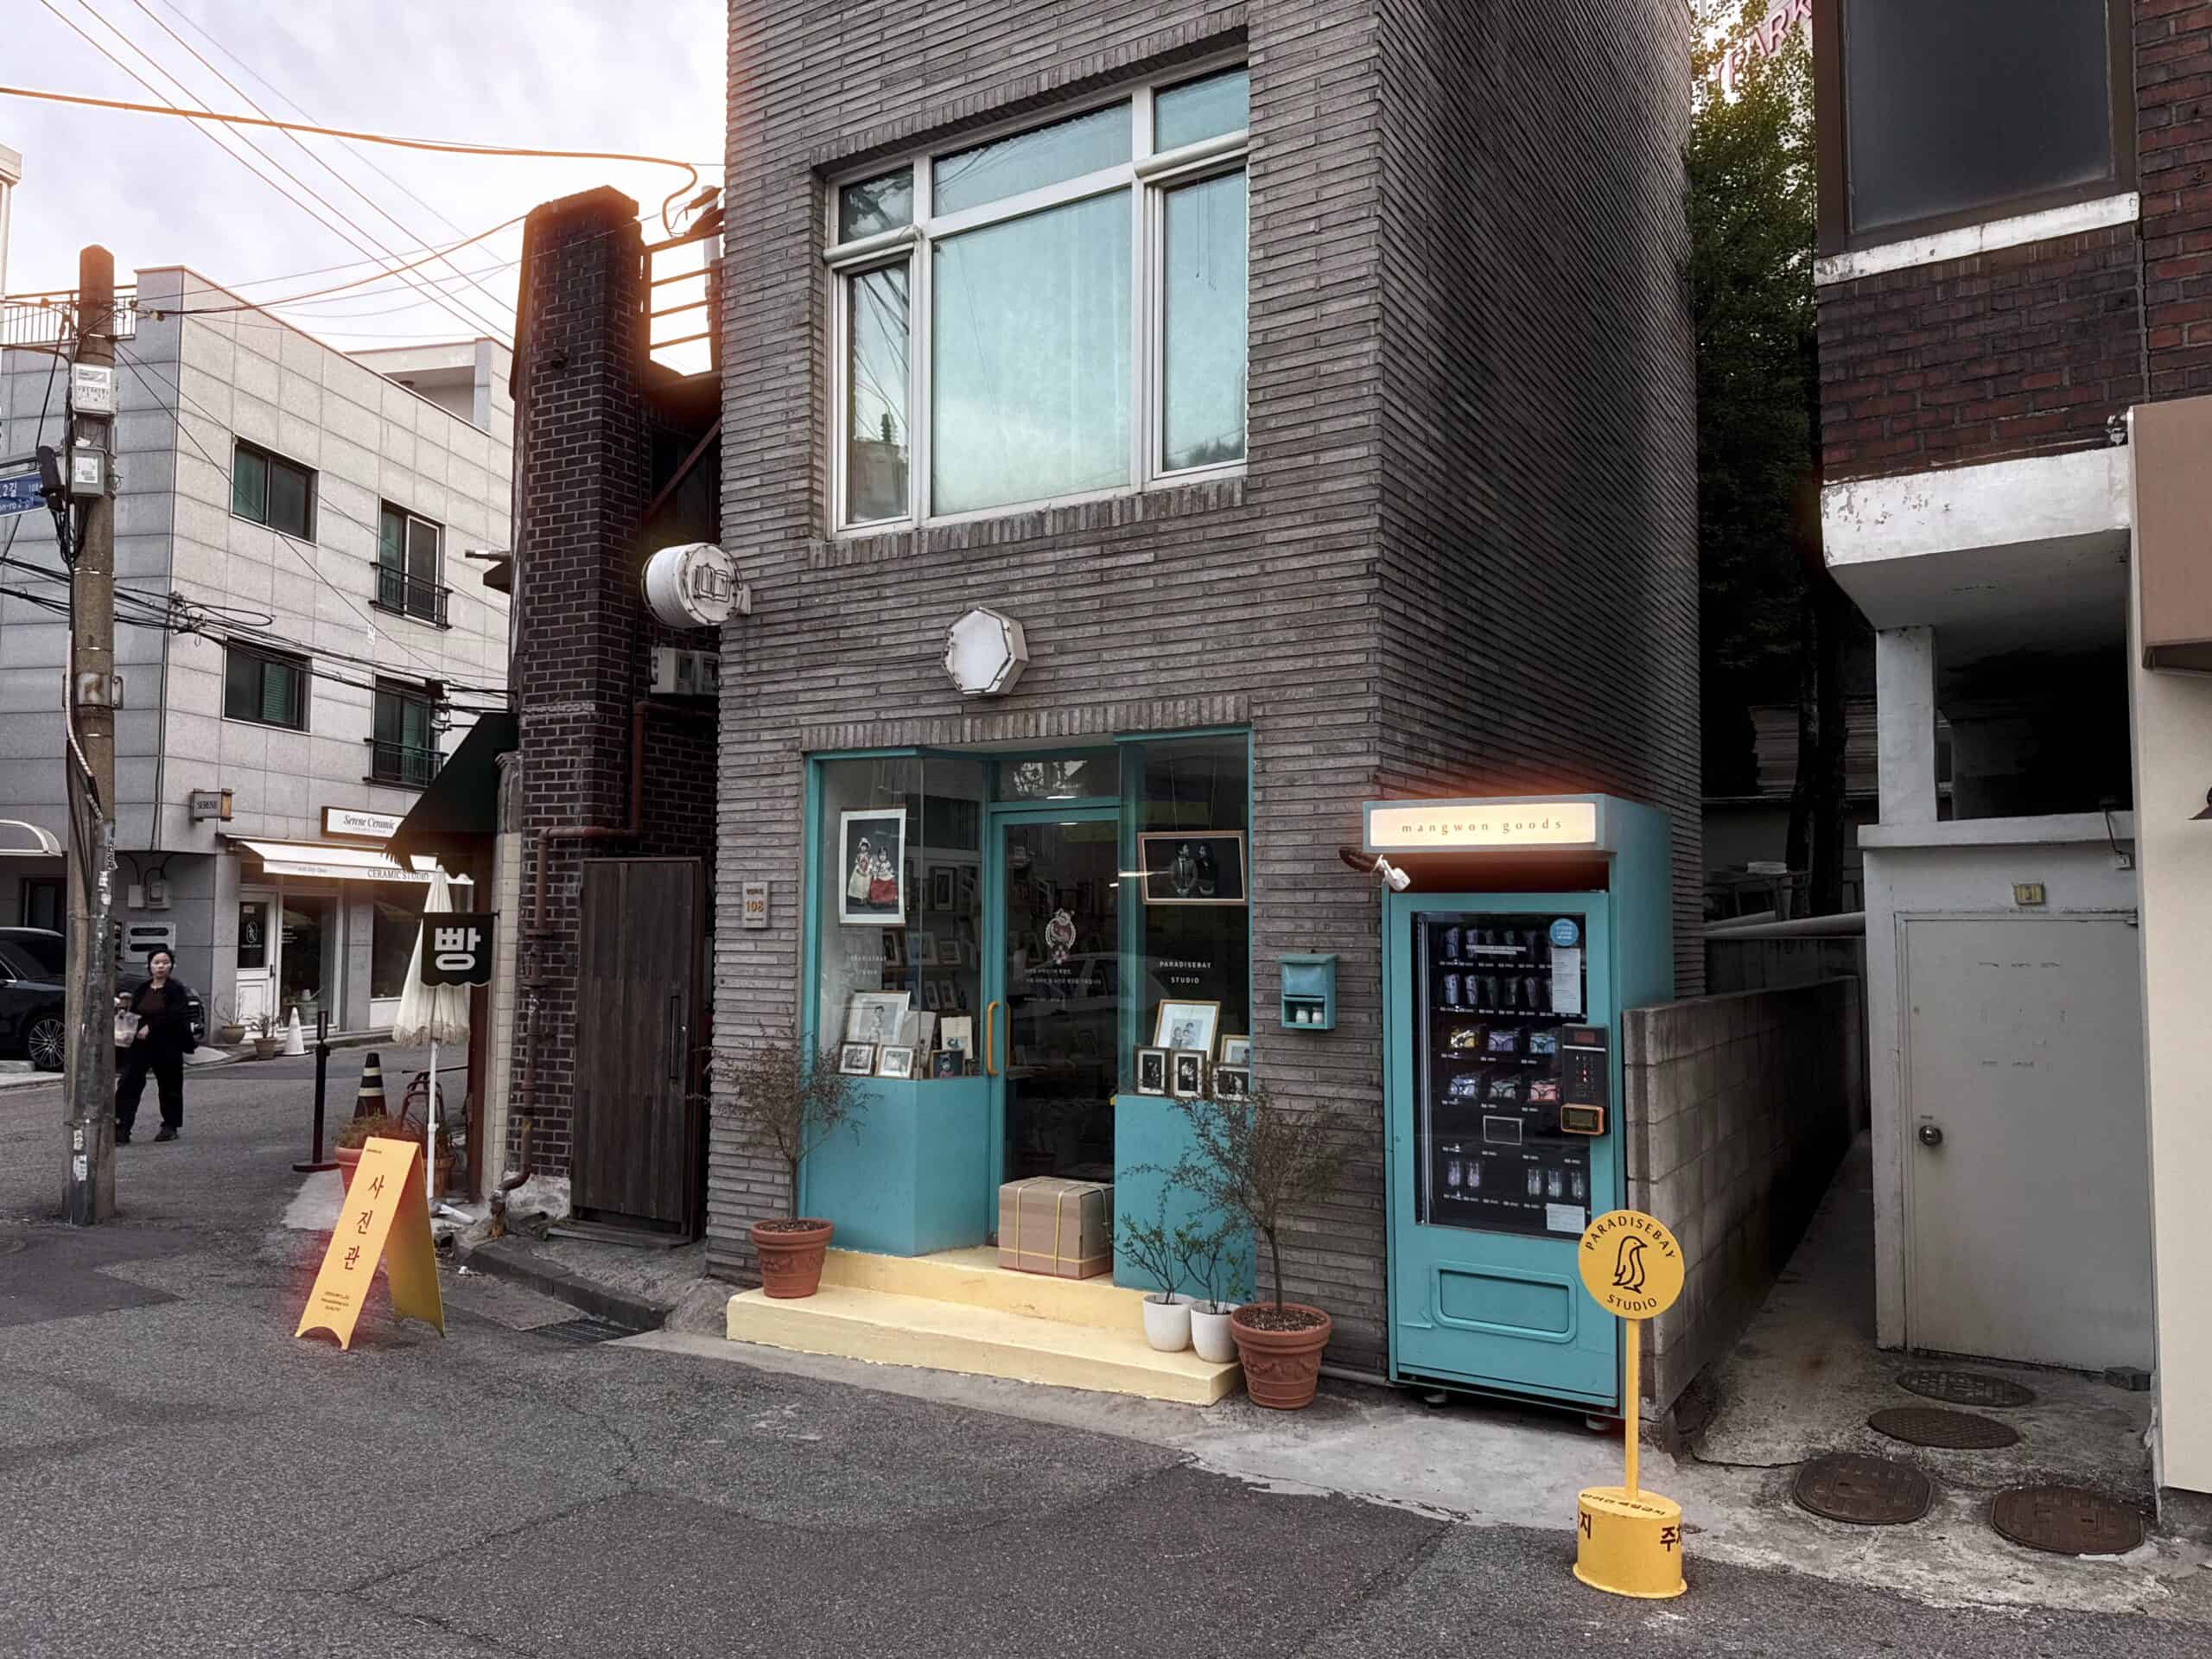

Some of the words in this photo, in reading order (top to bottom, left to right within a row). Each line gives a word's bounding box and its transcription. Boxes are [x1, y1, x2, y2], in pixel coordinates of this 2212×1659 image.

[344, 815, 366, 826] Serene
[367, 816, 396, 830] Ceramic
[1402, 823, 1489, 836] mangwon
[1502, 817, 1561, 834] goods
[367, 869, 401, 880] CERAMIC
[435, 927, 481, 970] 빵
[1160, 960, 1211, 969] PARADISEBAY
[344, 1174, 385, 1271] 사진관
[1585, 1216, 1676, 1258] PARADISEBAY
[1606, 1294, 1657, 1312] STUDIO
